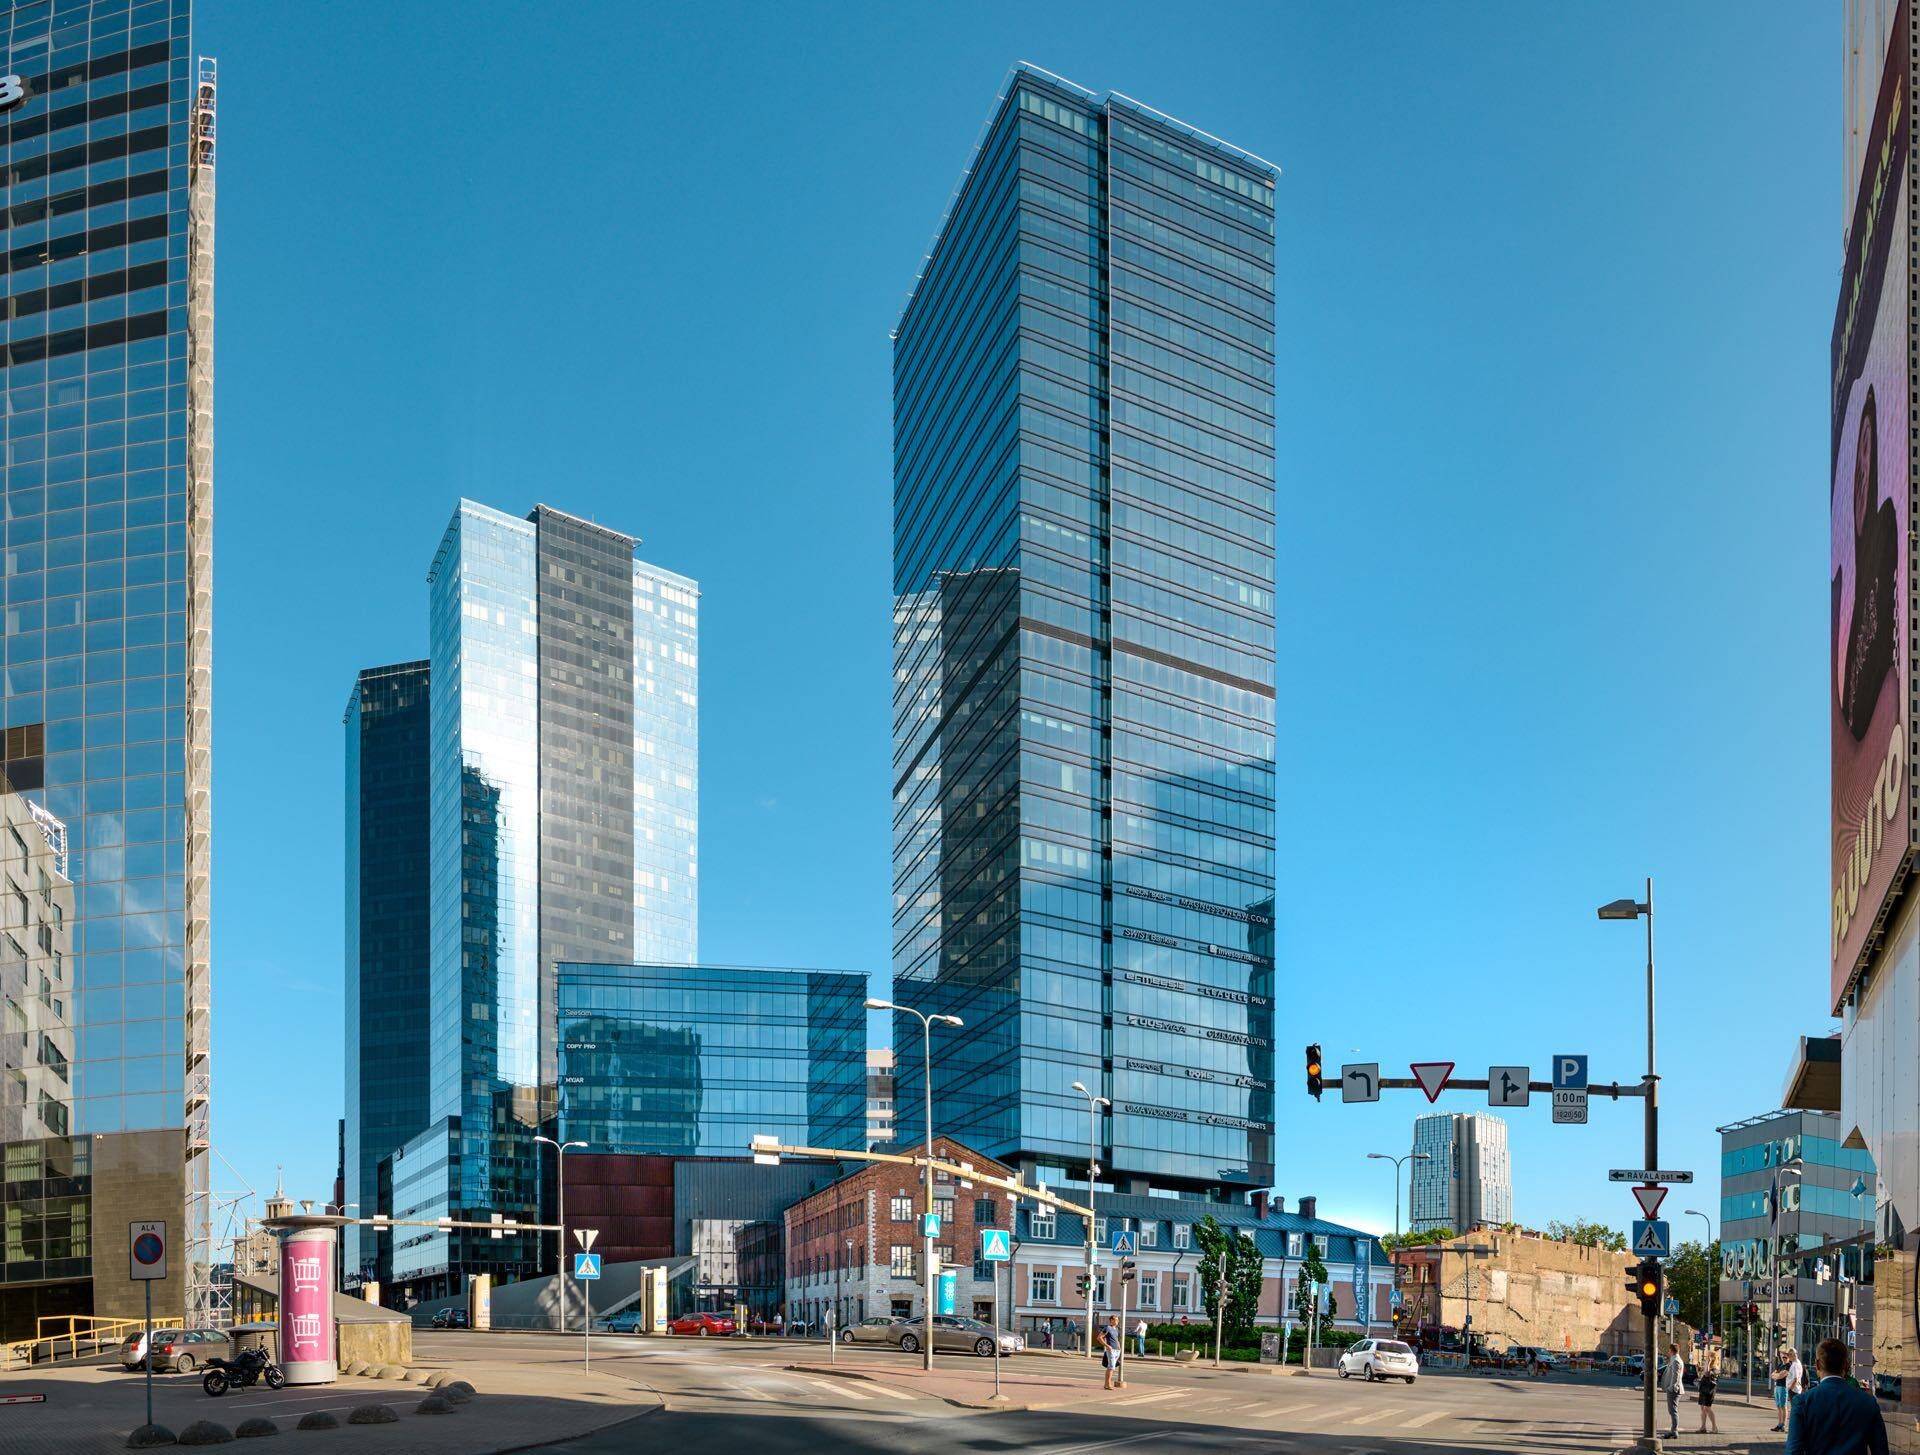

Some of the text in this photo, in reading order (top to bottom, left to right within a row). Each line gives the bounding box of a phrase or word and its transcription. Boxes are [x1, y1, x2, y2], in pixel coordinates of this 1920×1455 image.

[1833, 722, 1904, 961] PLUUTO
[1251, 996, 1266, 1005] PILV
[1561, 1058, 1580, 1085] P
